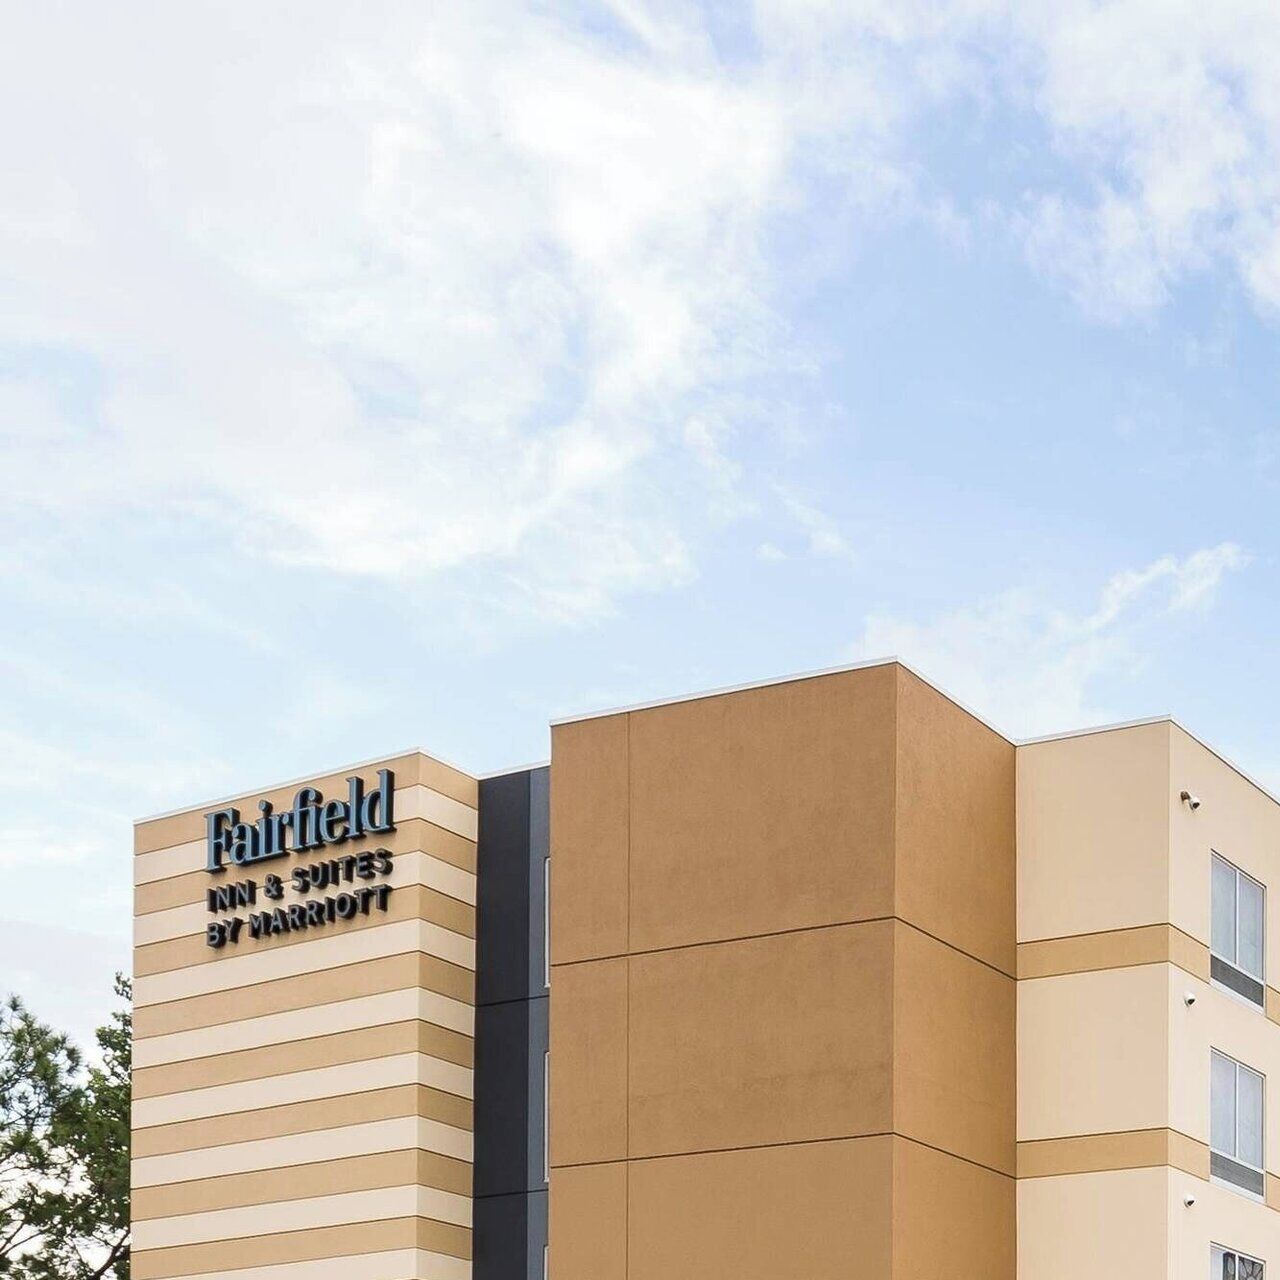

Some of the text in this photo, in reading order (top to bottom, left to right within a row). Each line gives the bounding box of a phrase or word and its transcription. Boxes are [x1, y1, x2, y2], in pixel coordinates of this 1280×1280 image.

[204, 769, 395, 872] Fairfield
[207, 848, 393, 913] INN & SUITES
[207, 884, 392, 948] BY MARRIOTT
